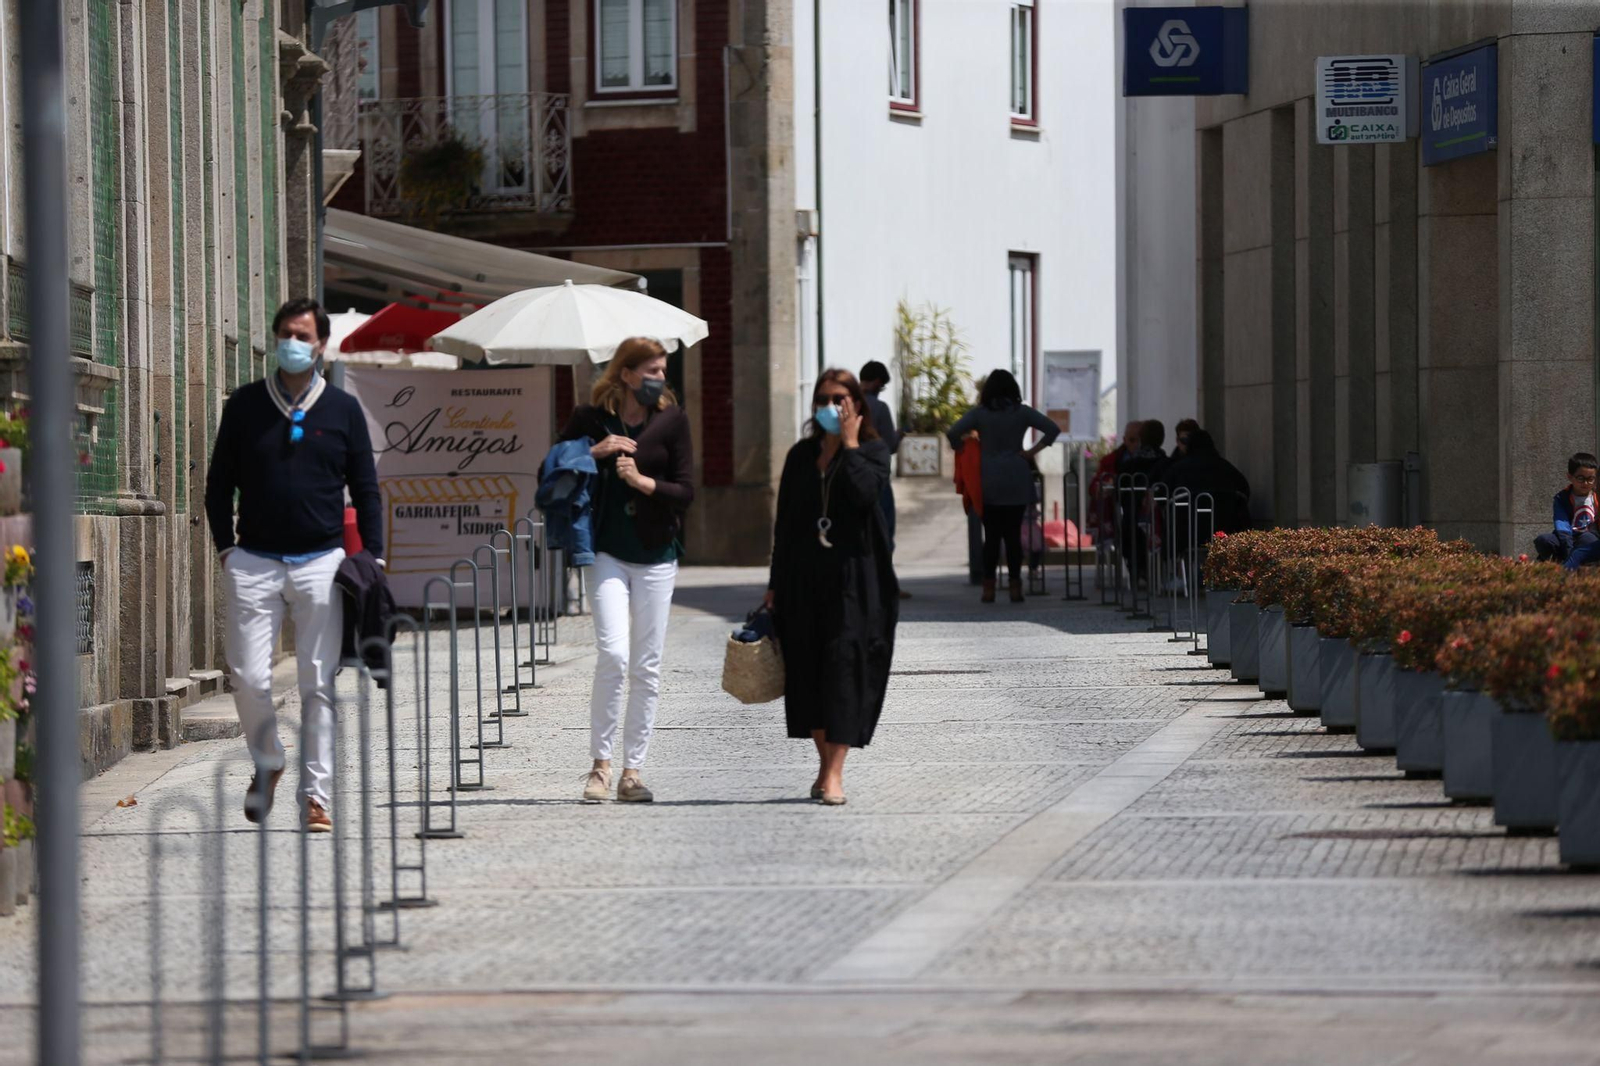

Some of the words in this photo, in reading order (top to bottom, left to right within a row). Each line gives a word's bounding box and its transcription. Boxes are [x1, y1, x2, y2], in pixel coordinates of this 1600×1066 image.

[1442, 74, 1459, 100] Caixa
[1459, 66, 1477, 95] Geral
[1325, 106, 1399, 117] MULTIBANCO
[1443, 107, 1450, 129] de
[1350, 124, 1395, 132] CAIXA
[451, 388, 523, 396] RESTAURANTE
[443, 405, 517, 429] Cantinho
[372, 407, 523, 470] Amigos
[395, 504, 481, 519] GARRAFEIRA
